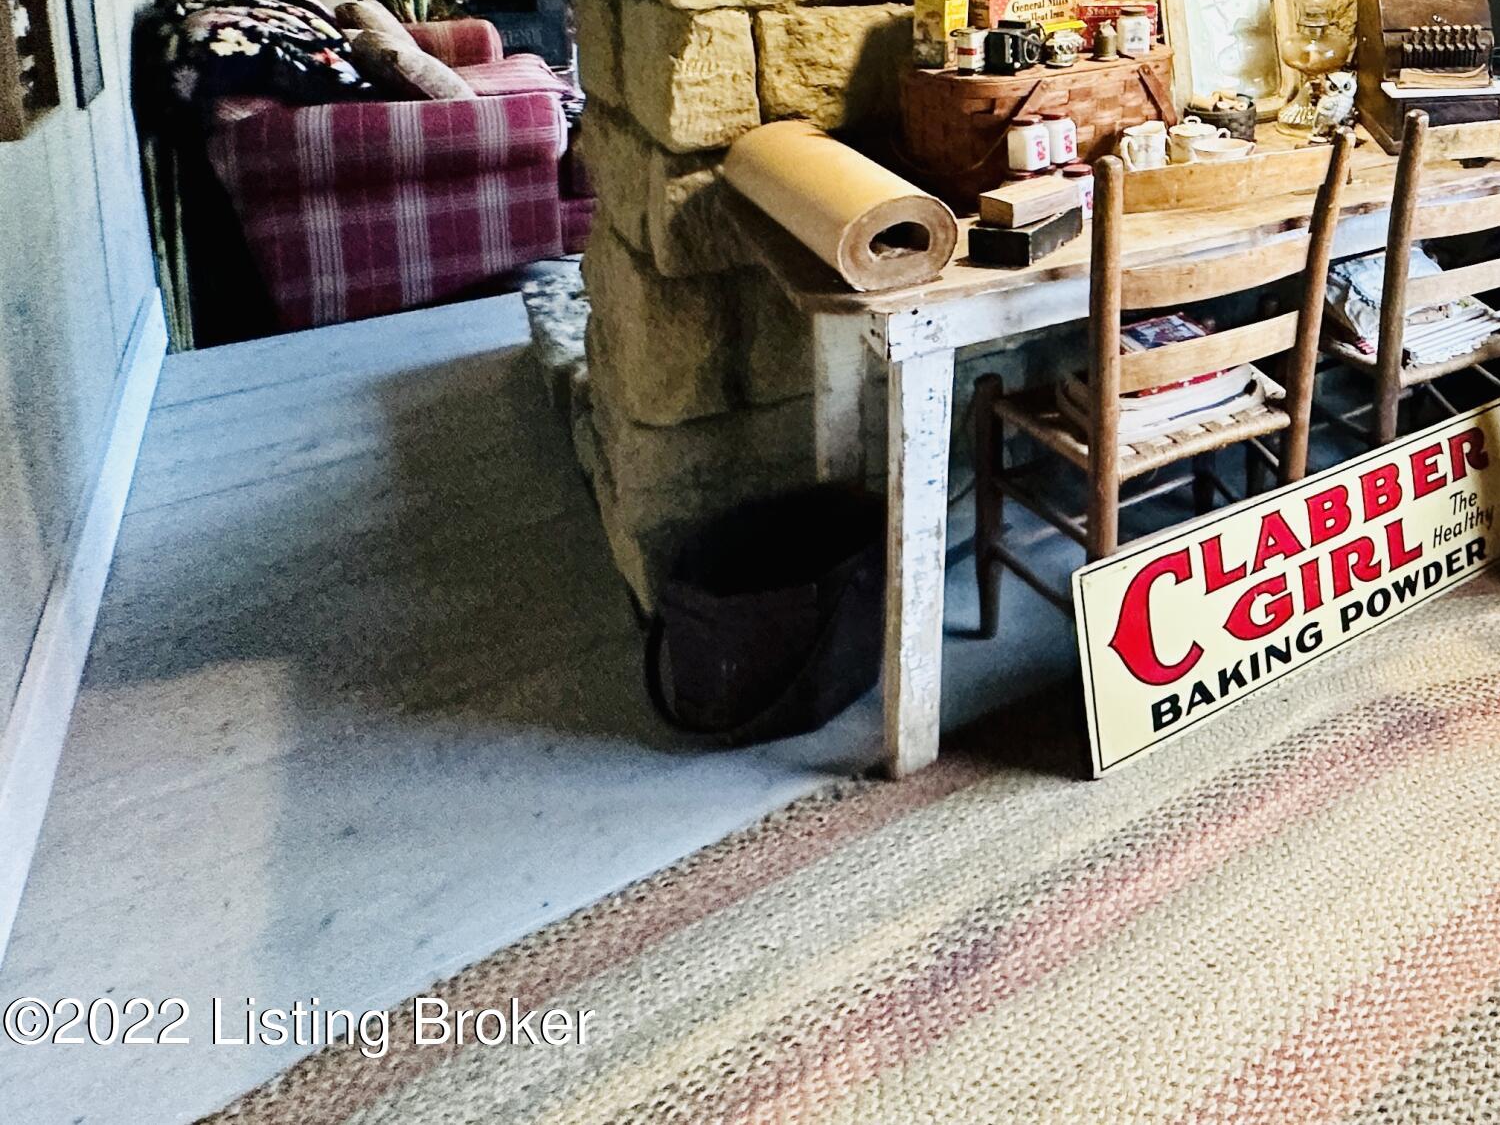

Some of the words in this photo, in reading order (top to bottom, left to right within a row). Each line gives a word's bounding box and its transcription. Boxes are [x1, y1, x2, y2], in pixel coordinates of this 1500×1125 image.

[1107, 426, 1489, 687] CLABBER
[1432, 503, 1495, 549] Healthy
[1449, 489, 1478, 516] The
[1151, 621, 1323, 733] BAKING
[1339, 537, 1487, 633] POWDER
[1222, 518, 1423, 641] GIRL
